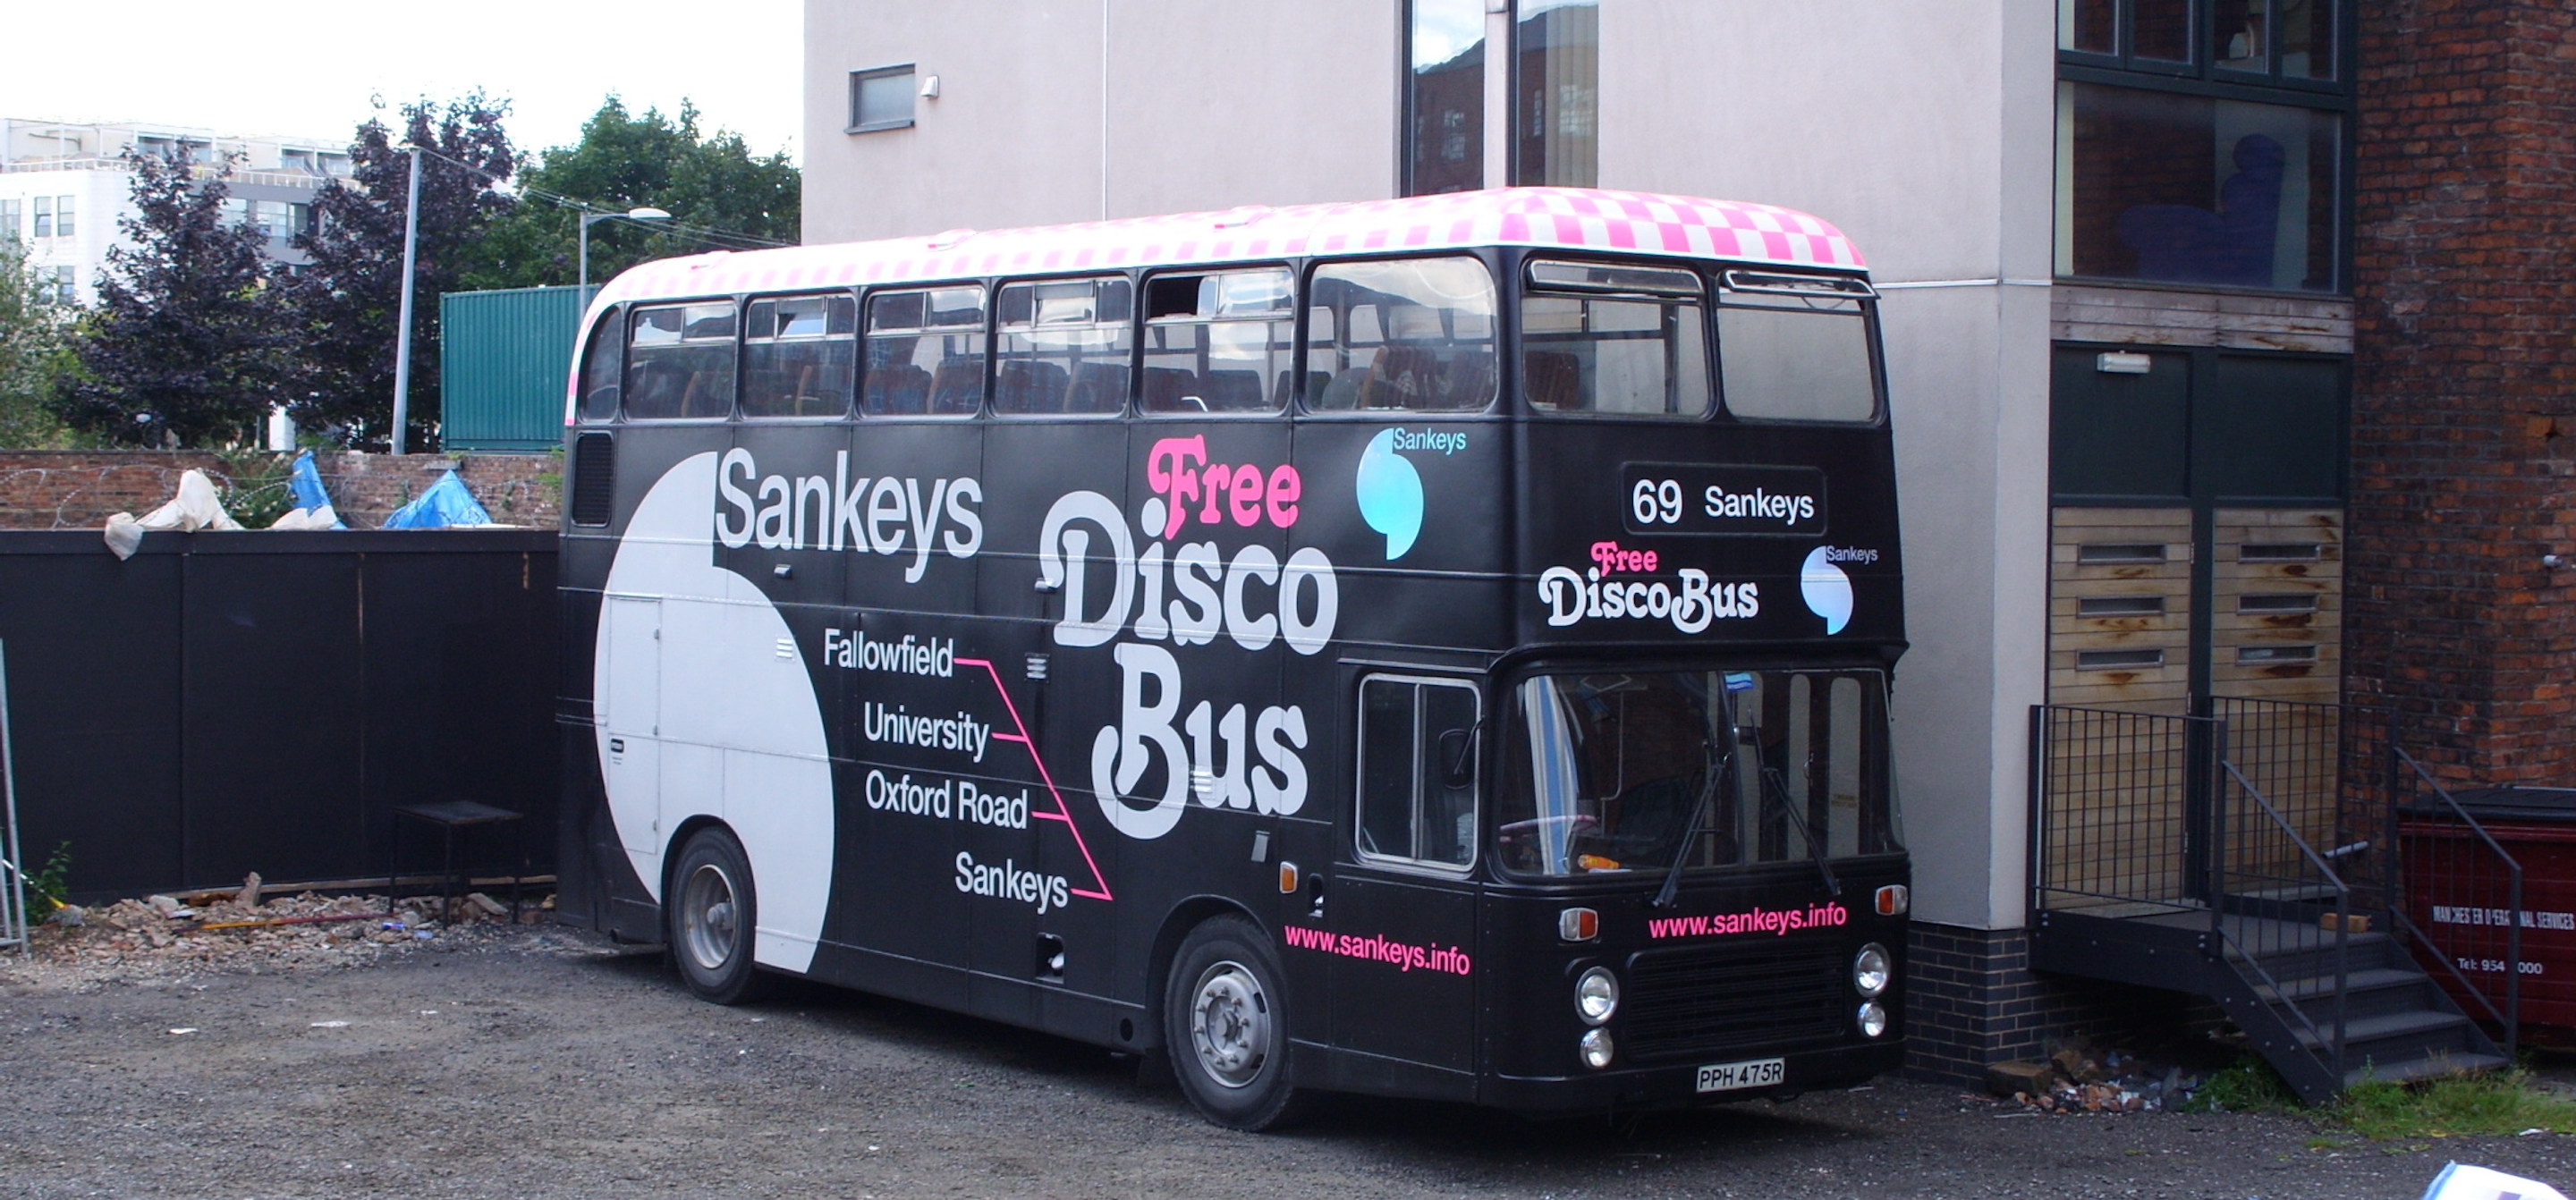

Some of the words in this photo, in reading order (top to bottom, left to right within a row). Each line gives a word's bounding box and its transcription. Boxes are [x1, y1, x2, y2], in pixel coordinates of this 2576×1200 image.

[1394, 427, 1467, 455] Sankeys
[1147, 434, 1302, 540] Free
[1632, 478, 1683, 524] 69
[1705, 486, 1815, 525] Sankeys
[716, 446, 983, 584] Sankeys
[1039, 490, 1339, 656] Disco
[1589, 540, 1658, 578] Free
[1826, 545, 1878, 563] Sankeys
[824, 628, 954, 678] Fallowfield
[864, 701, 989, 764] University
[1090, 642, 1309, 841] Bus
[865, 769, 951, 819] Oxford
[958, 785, 1028, 830] Road
[955, 851, 1069, 915] Sankeys
[1648, 901, 1847, 938] www.sankeys.info
[2433, 905, 2484, 925] MANCHESER
[1284, 925, 1470, 976] www.sankeys.info
[1699, 1067, 1734, 1089] PPH
[1739, 1061, 1783, 1085] 475R
